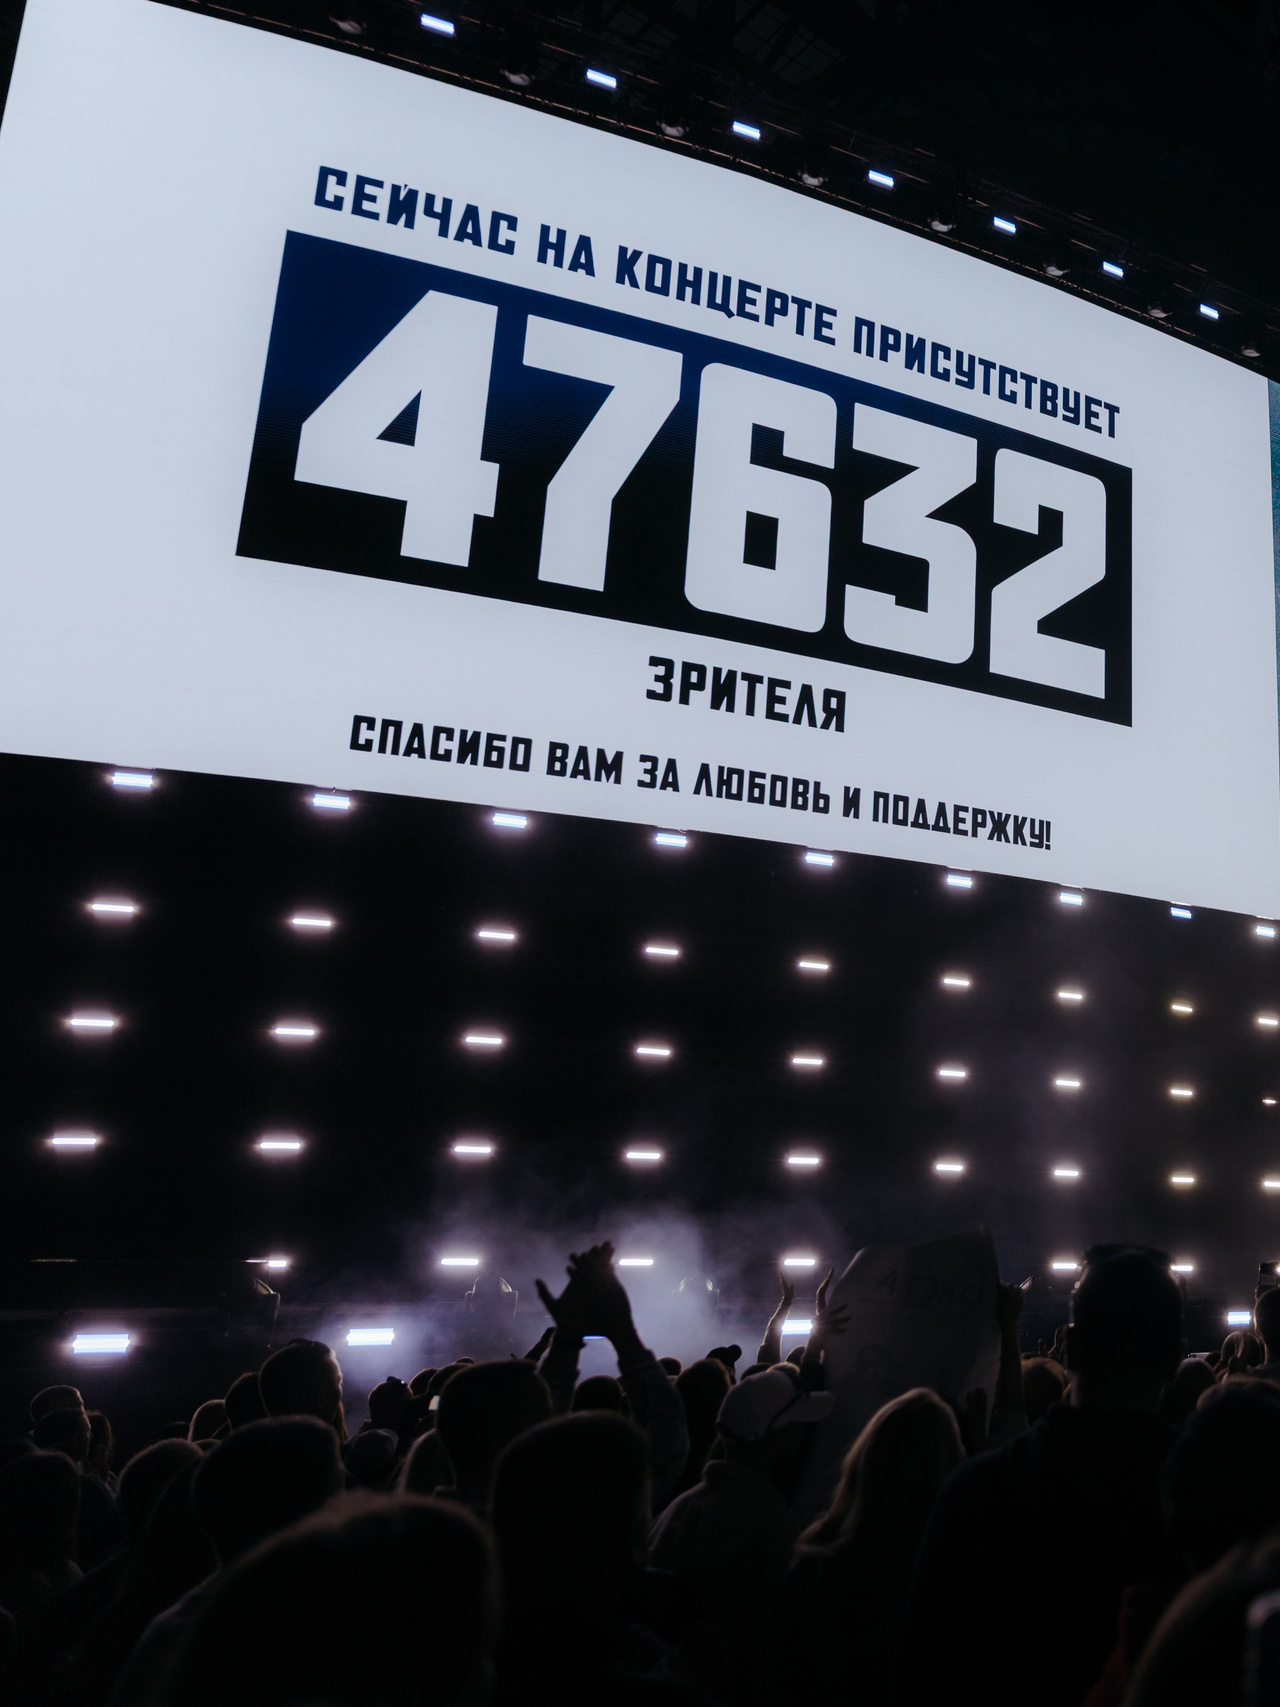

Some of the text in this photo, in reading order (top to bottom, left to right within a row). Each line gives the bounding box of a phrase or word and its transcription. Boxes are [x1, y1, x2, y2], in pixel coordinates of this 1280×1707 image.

[314, 165, 1121, 439] СЕЙЧАС НА КОНЦЕРТЕ ПРИСУТСТВУЕТ
[294, 289, 1107, 700] 47632
[350, 714, 1052, 851] СПАСИБО ВАМ ЗА ЛЮБОВЬ И ПОДДЕРЖКУ!
[646, 655, 847, 734] ЗРИТЕЛЯ
